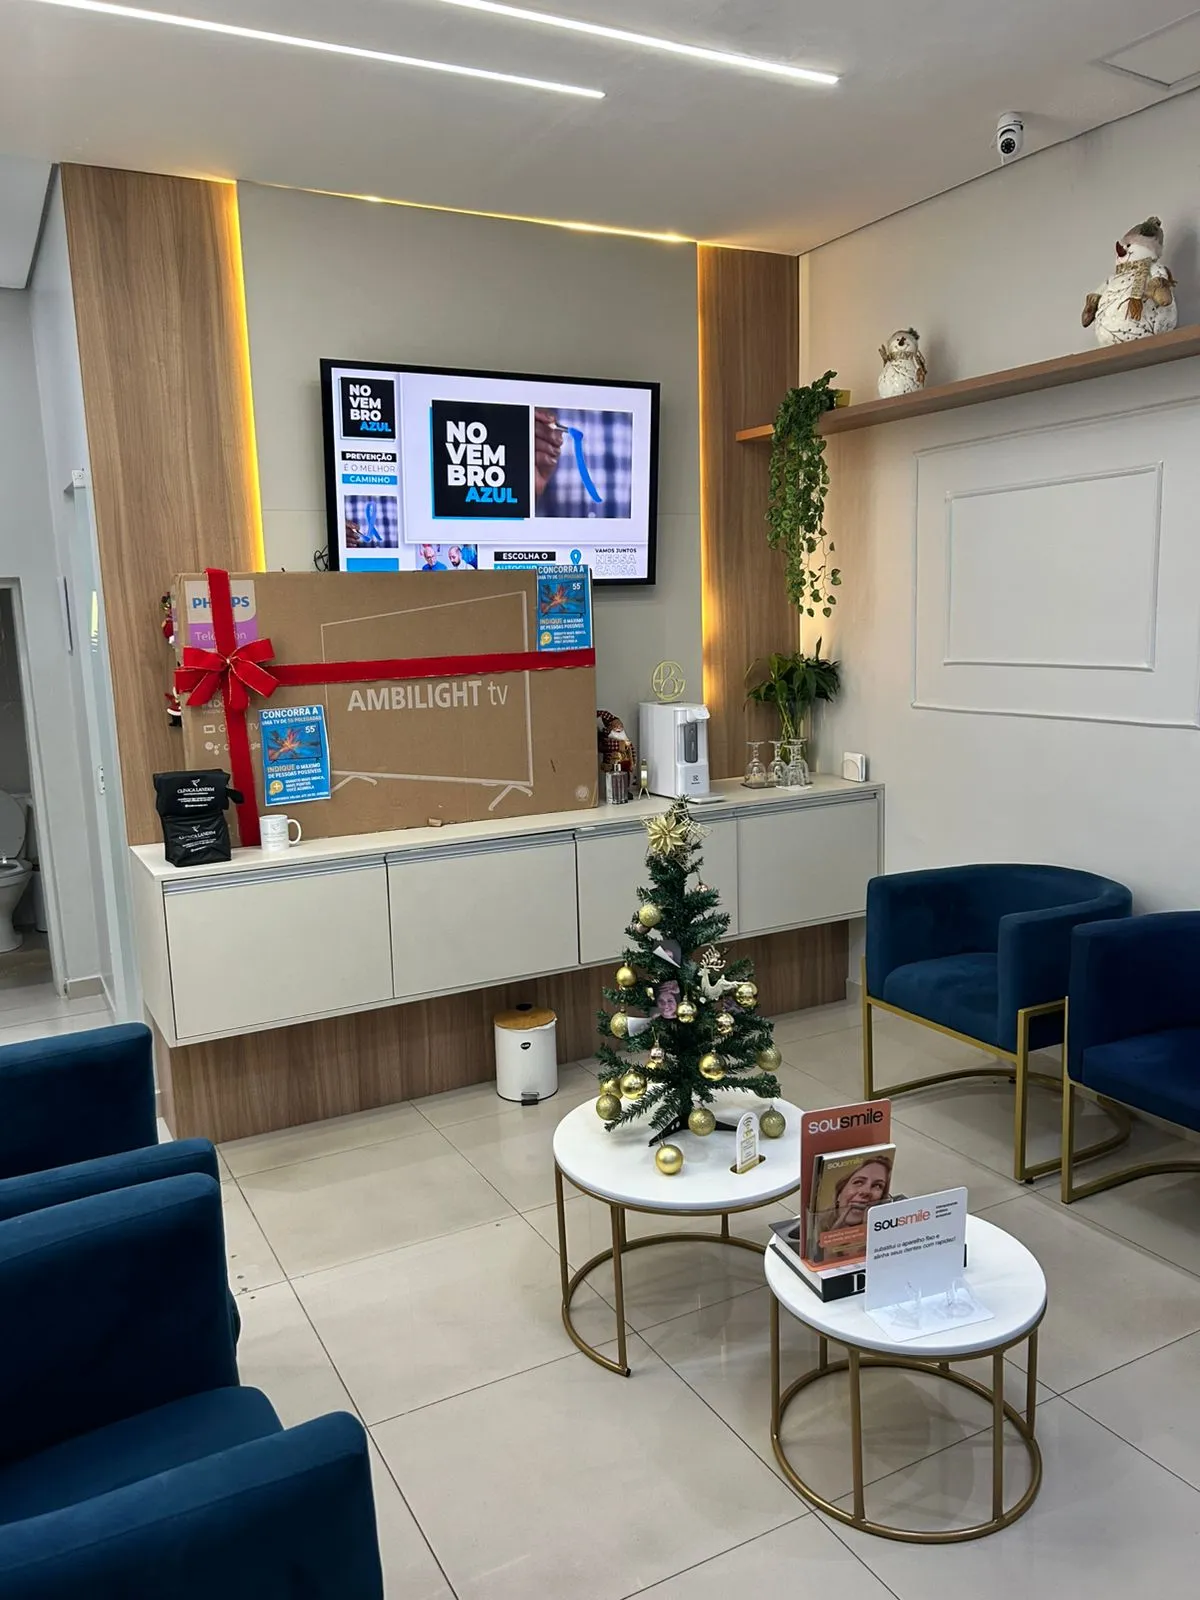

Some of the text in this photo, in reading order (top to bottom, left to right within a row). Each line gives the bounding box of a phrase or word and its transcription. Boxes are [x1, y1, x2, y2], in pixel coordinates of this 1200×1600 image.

[349, 384, 372, 396] NO
[349, 396, 381, 410] VEM
[350, 409, 381, 421] BRO
[360, 422, 392, 432] AZUL
[446, 420, 487, 444] NO
[346, 452, 392, 462] PREVENÇÃO
[445, 442, 505, 466] VEM
[448, 464, 505, 488] BRO
[465, 486, 518, 503] AZUL
[596, 554, 637, 565] NESSA
[192, 596, 250, 608] PHPS
[347, 680, 508, 711] AMBILIGHT tv
[263, 708, 310, 719] CONCORRA
[267, 764, 295, 773] INDIQUE
[808, 1108, 883, 1134] sousmile
[874, 1209, 930, 1231] sousmile
